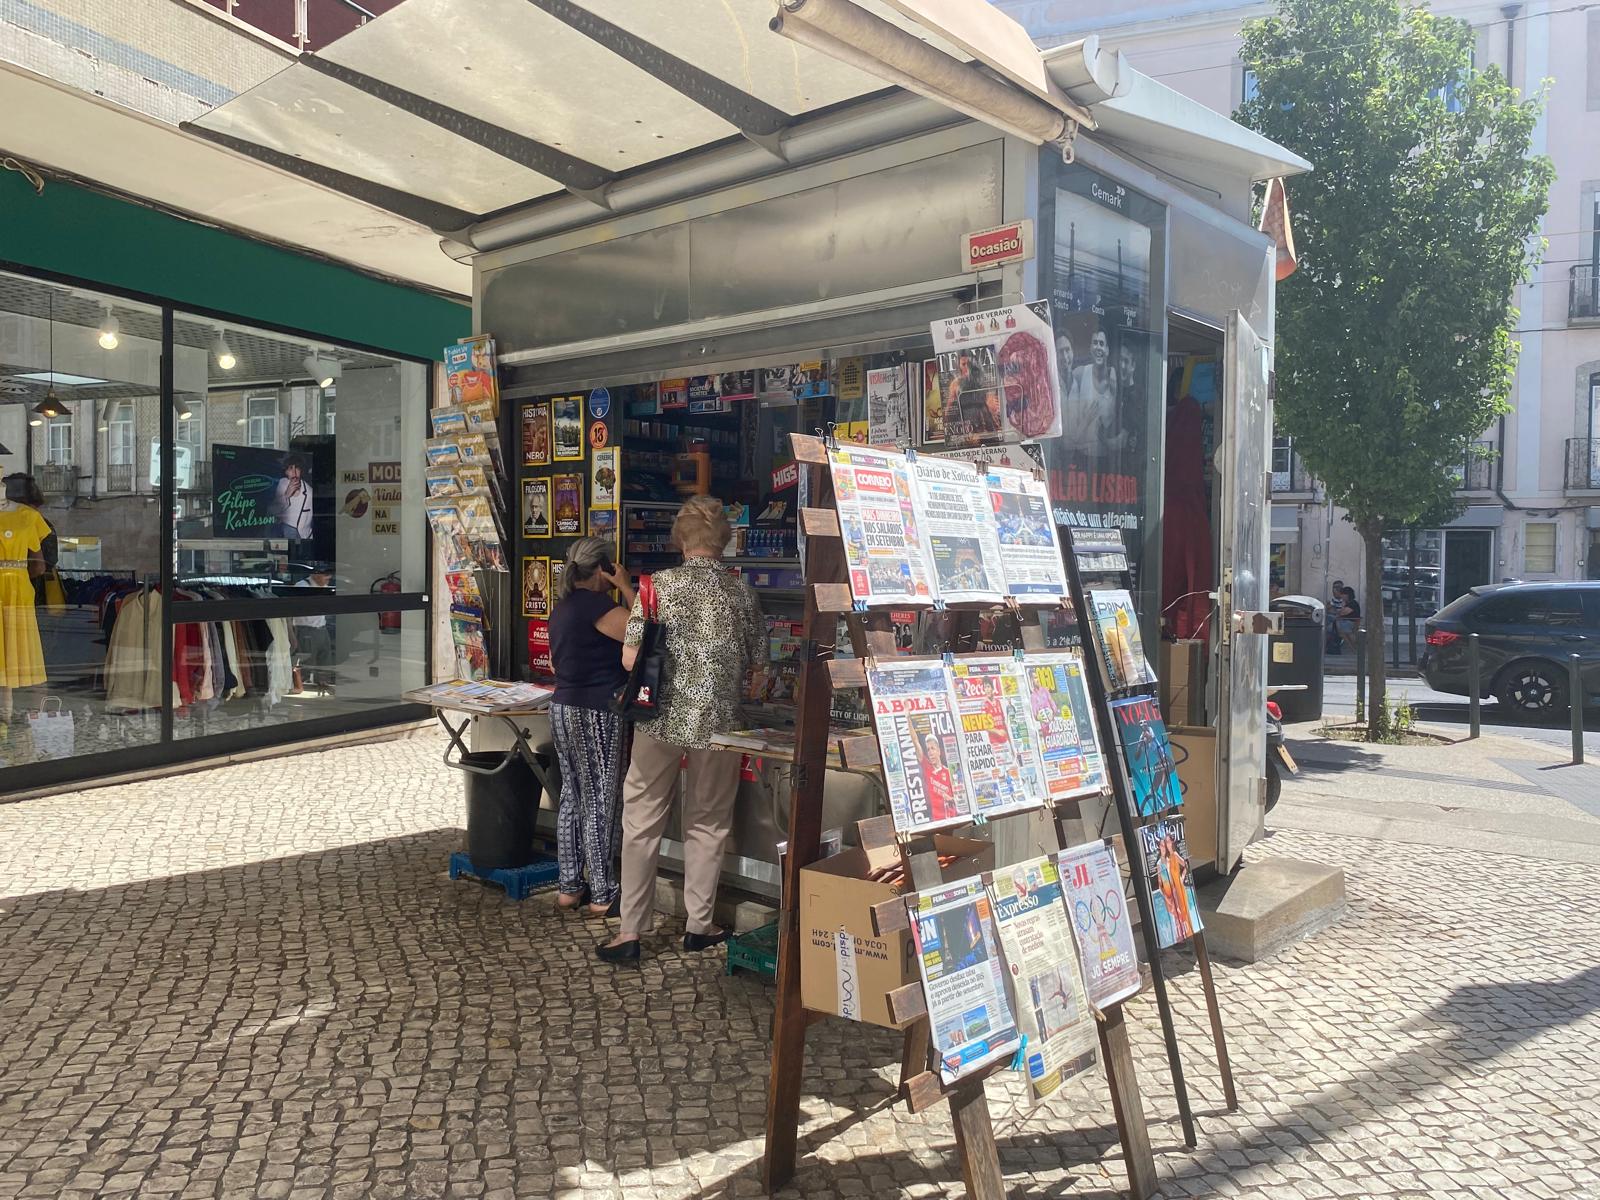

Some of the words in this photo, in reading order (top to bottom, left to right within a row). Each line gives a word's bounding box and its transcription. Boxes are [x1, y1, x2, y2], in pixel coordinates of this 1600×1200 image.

[1092, 183, 1122, 208] Cemark
[971, 238, 1018, 258] Ocasião
[954, 315, 975, 325] BOLSO
[976, 313, 985, 321] DE
[986, 308, 1013, 319] VERANO
[936, 347, 995, 373] TEVA
[950, 450, 970, 458] BOLSO
[344, 472, 365, 482] MAIS
[772, 464, 797, 488] HIGS
[857, 473, 892, 487] CORREIO
[915, 465, 941, 479] Diário
[942, 468, 952, 480] de
[1092, 472, 1137, 505] LISBOA
[218, 490, 257, 512] Filipe
[992, 492, 1003, 512] P
[225, 511, 275, 530] Karlsson
[375, 510, 386, 519] NA
[1076, 510, 1088, 527] de
[1088, 513, 1101, 528] um
[1102, 512, 1138, 530] alfacinha
[376, 523, 397, 533] CAVE
[863, 522, 877, 534] NOS
[866, 534, 876, 546] EM
[876, 535, 905, 548] SETEMBRO
[526, 601, 546, 609] CRISTO
[1097, 601, 1132, 615] PRIMA
[876, 702, 890, 714] A
[892, 697, 936, 713] BOLA
[844, 710, 852, 719] OF
[929, 712, 955, 735] FICA
[961, 713, 994, 733] NEVES
[965, 733, 983, 744] PARA
[968, 744, 992, 758] FECHAR
[970, 757, 996, 771] RÁPIDO
[1072, 864, 1093, 890] JL
[998, 895, 1039, 919] Expresso
[812, 928, 828, 938] 24H
[864, 939, 888, 950] LOJA
[1104, 951, 1130, 974] SEMPRE
